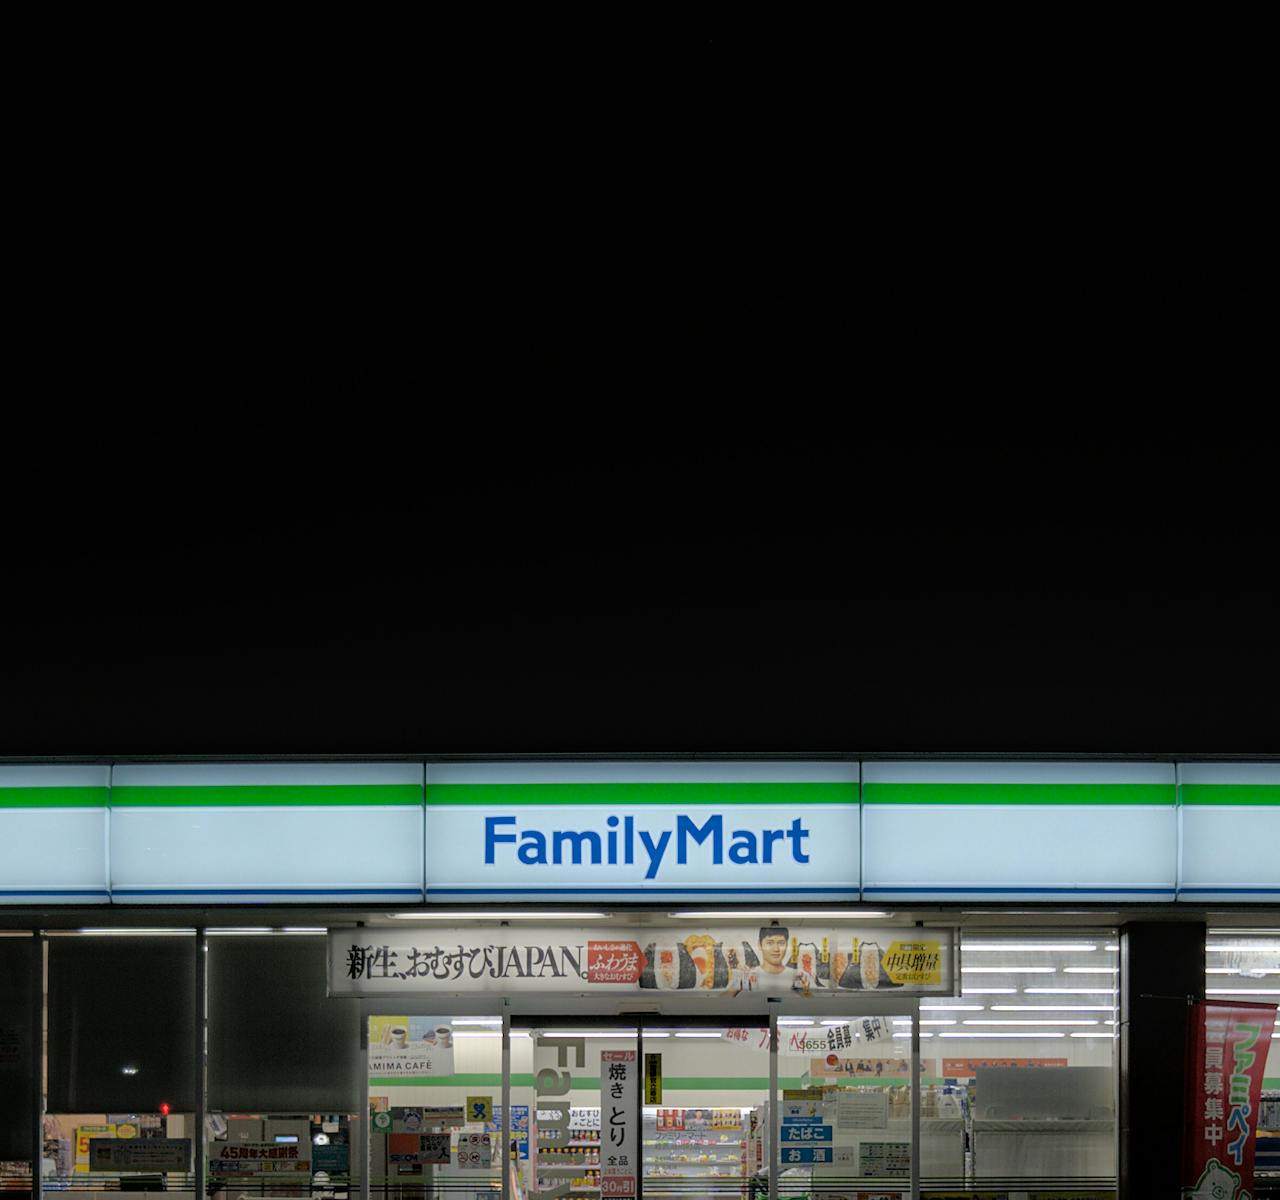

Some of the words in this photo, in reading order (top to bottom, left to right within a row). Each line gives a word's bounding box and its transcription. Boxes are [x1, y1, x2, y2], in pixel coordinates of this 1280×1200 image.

[484, 815, 809, 879] FamilyMart
[346, 944, 588, 981] 新生、おむすびJAPAN。
[608, 1063, 627, 1147] 焼きとり
[787, 1127, 825, 1140] たばこ
[607, 1155, 629, 1166] 全品
[787, 1149, 826, 1162] お酒
